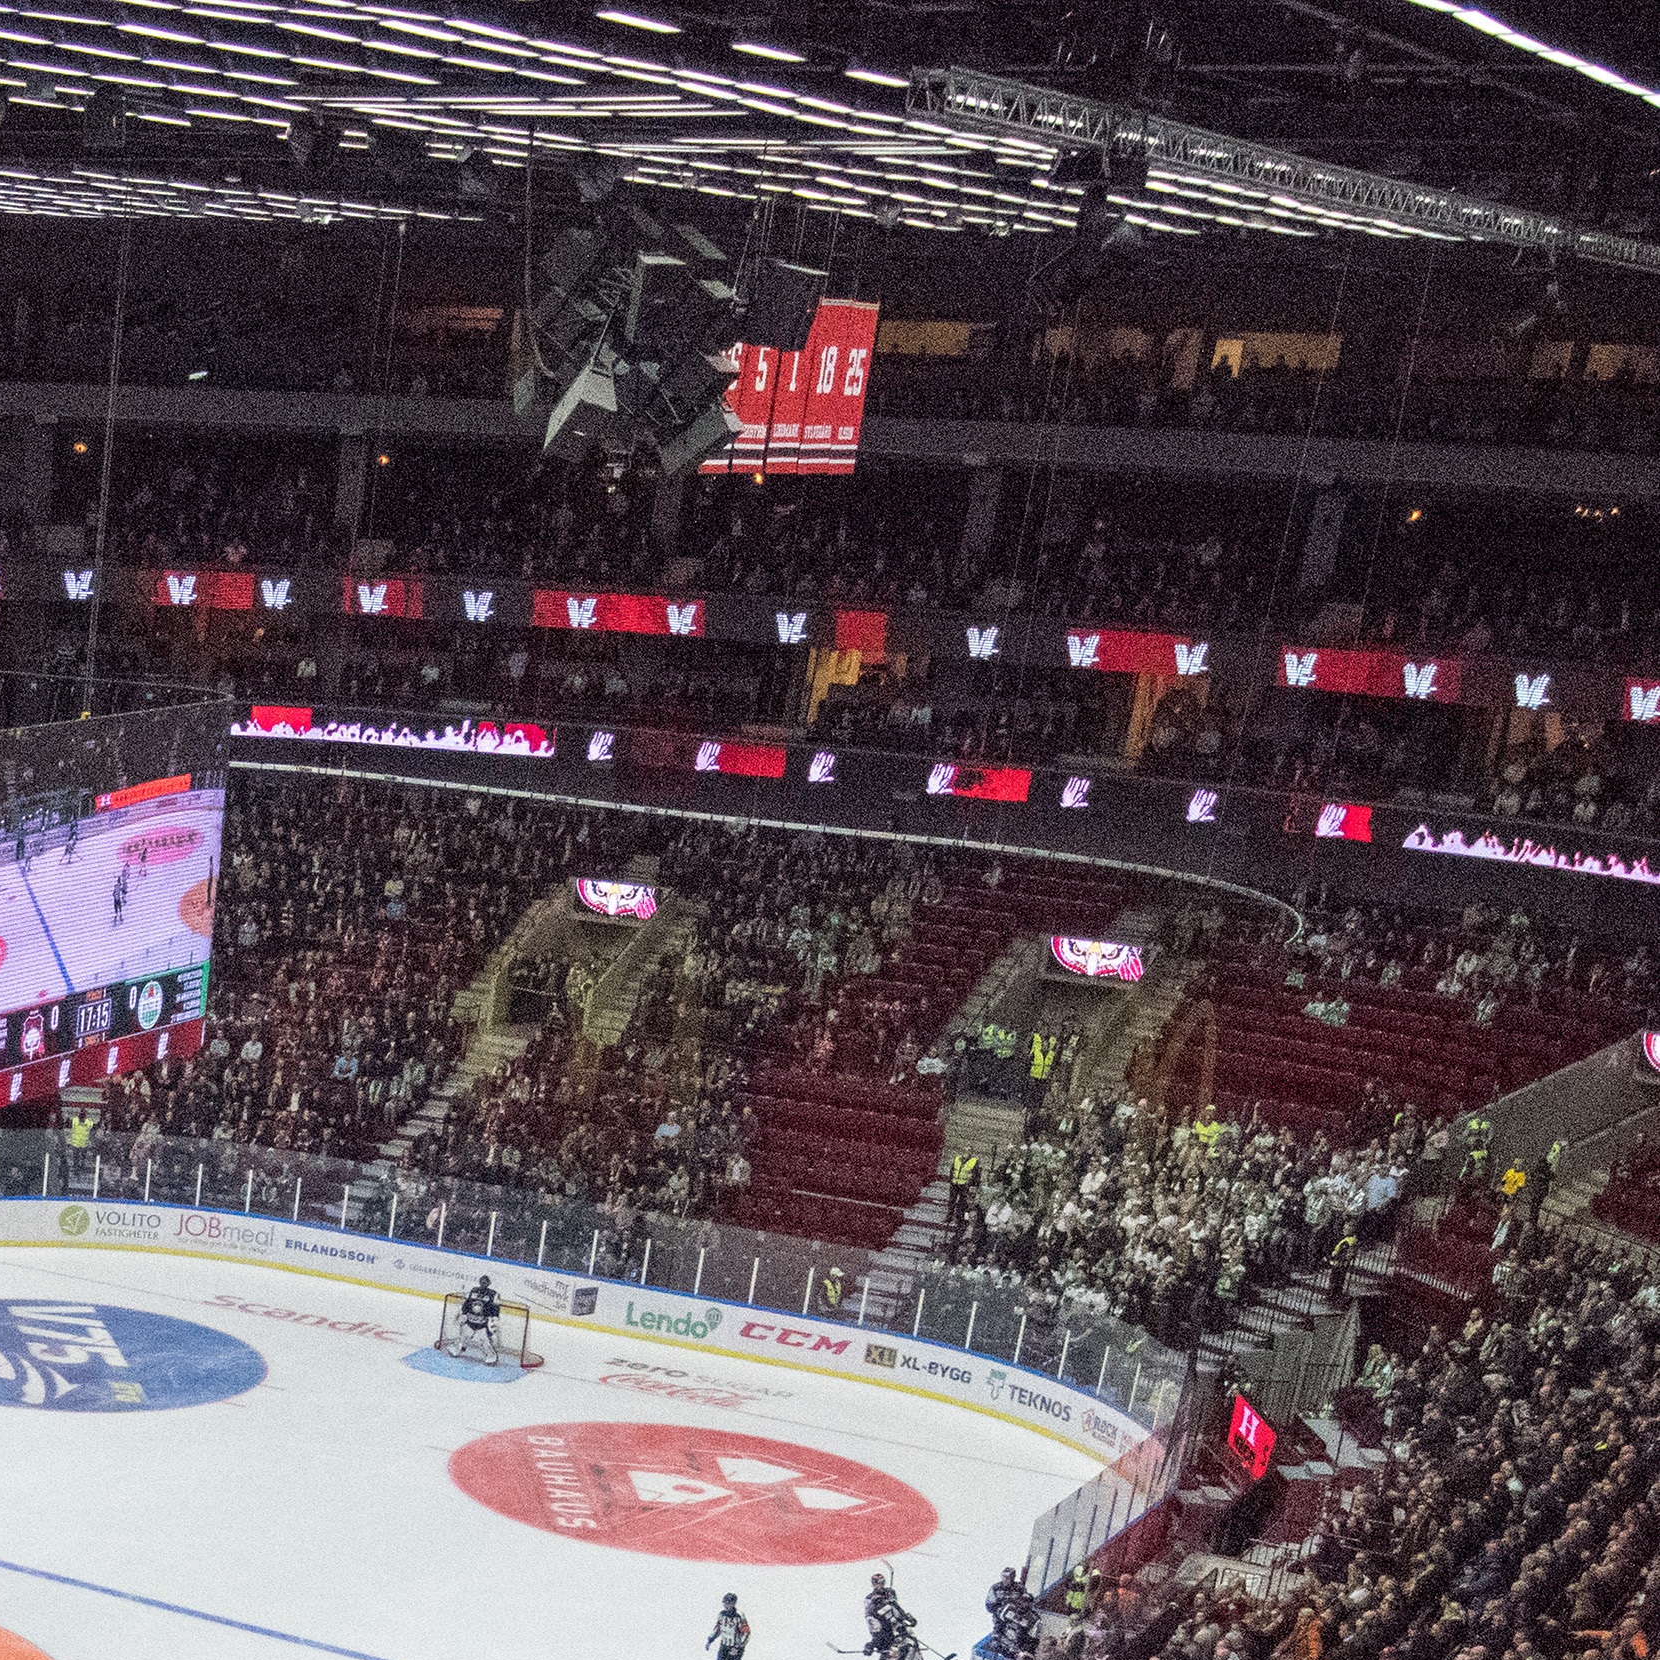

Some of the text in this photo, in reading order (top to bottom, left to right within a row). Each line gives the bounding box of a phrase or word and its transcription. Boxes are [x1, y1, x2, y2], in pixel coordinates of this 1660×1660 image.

[755, 347, 770, 391] 5
[789, 351, 800, 392] 1
[816, 345, 838, 394] 18
[843, 348, 867, 396] 25
[129, 987, 137, 1010] 0
[51, 1005, 59, 1031] 0
[79, 1003, 109, 1033] 17:15
[95, 1227, 160, 1241] FASTIGHETER
[96, 1211, 161, 1229] VOLITO
[174, 1213, 275, 1249] JOBmeal
[285, 1239, 376, 1265] ERLANDSSON
[203, 1295, 407, 1342] Scandic
[626, 1302, 709, 1340] Lendo
[740, 1321, 852, 1357] CCM
[605, 1357, 689, 1378] zero
[900, 1354, 972, 1384] XL-BYGG
[1008, 1384, 1073, 1424] TEKNOS
[526, 1434, 597, 1530] BAUHAUS
